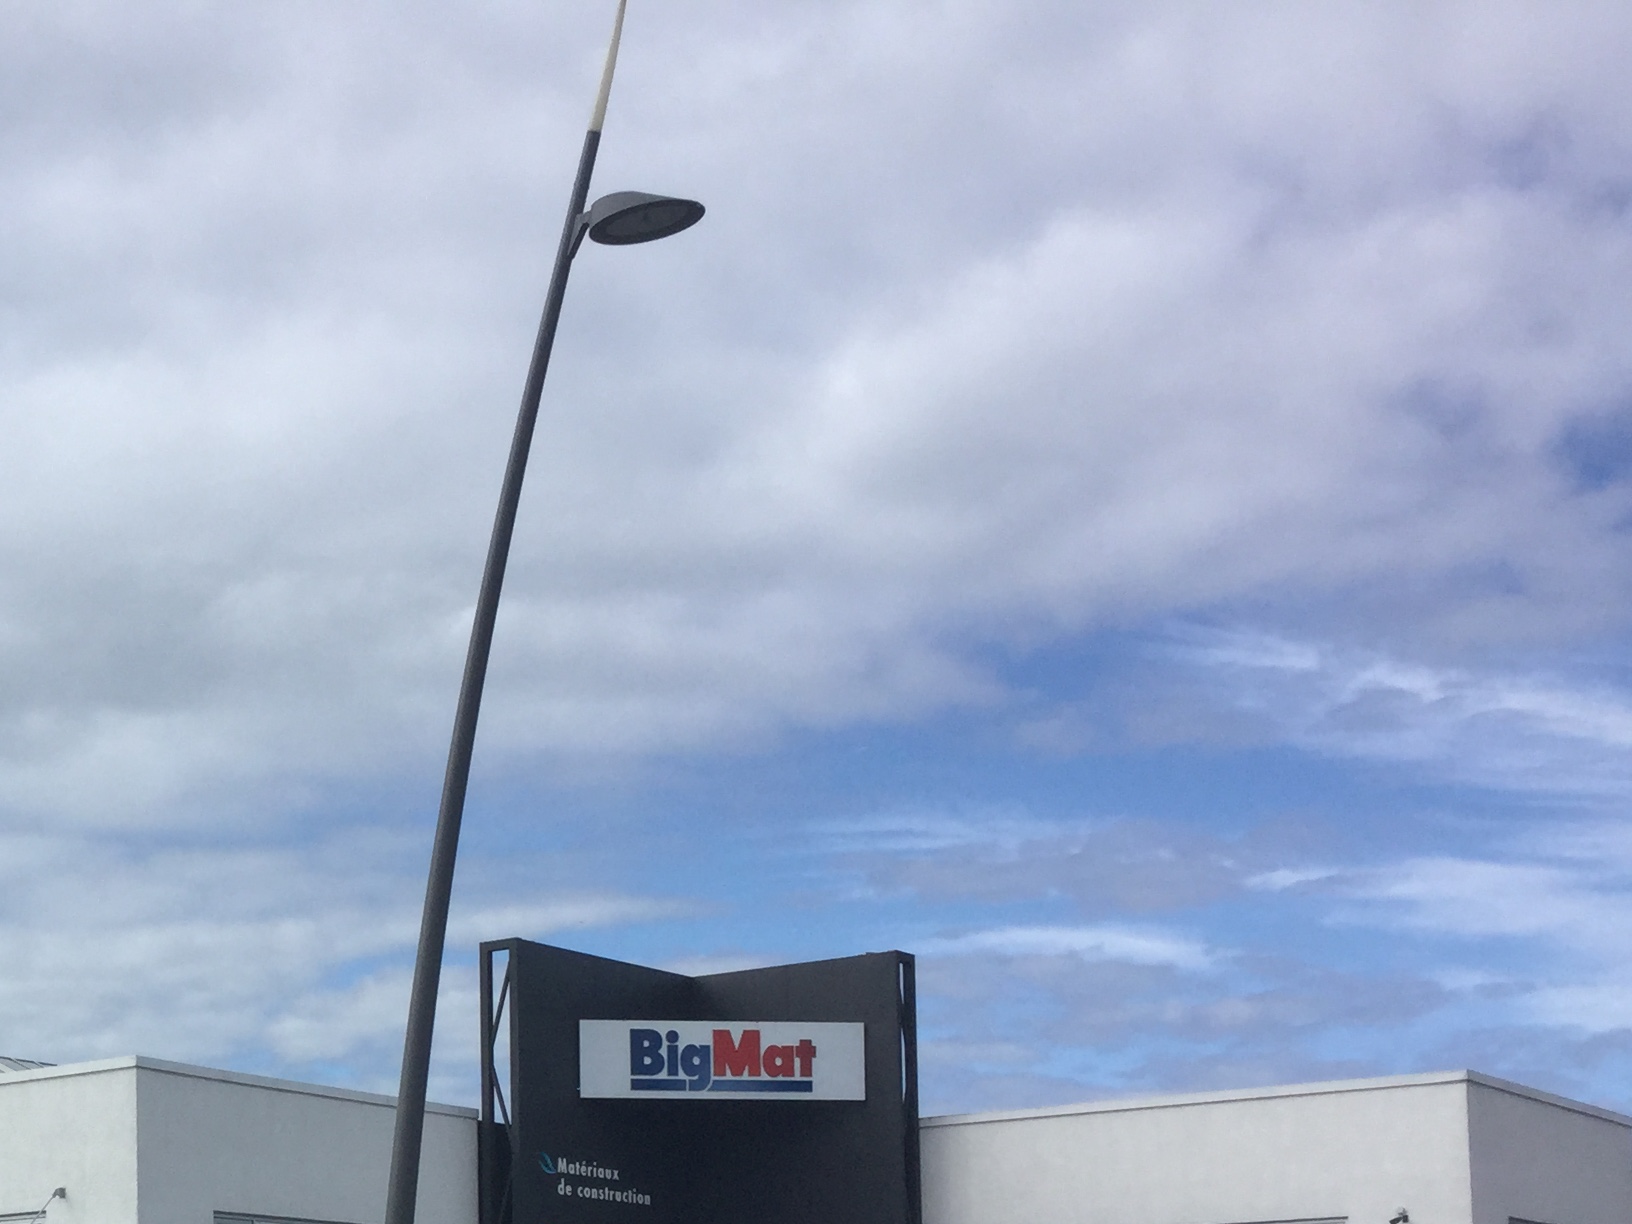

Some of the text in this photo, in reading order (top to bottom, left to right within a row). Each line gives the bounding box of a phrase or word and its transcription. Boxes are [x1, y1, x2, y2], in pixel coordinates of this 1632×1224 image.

[630, 1028, 817, 1091] BigMat
[557, 1156, 620, 1181] Matériaux
[557, 1178, 652, 1206] de construction
